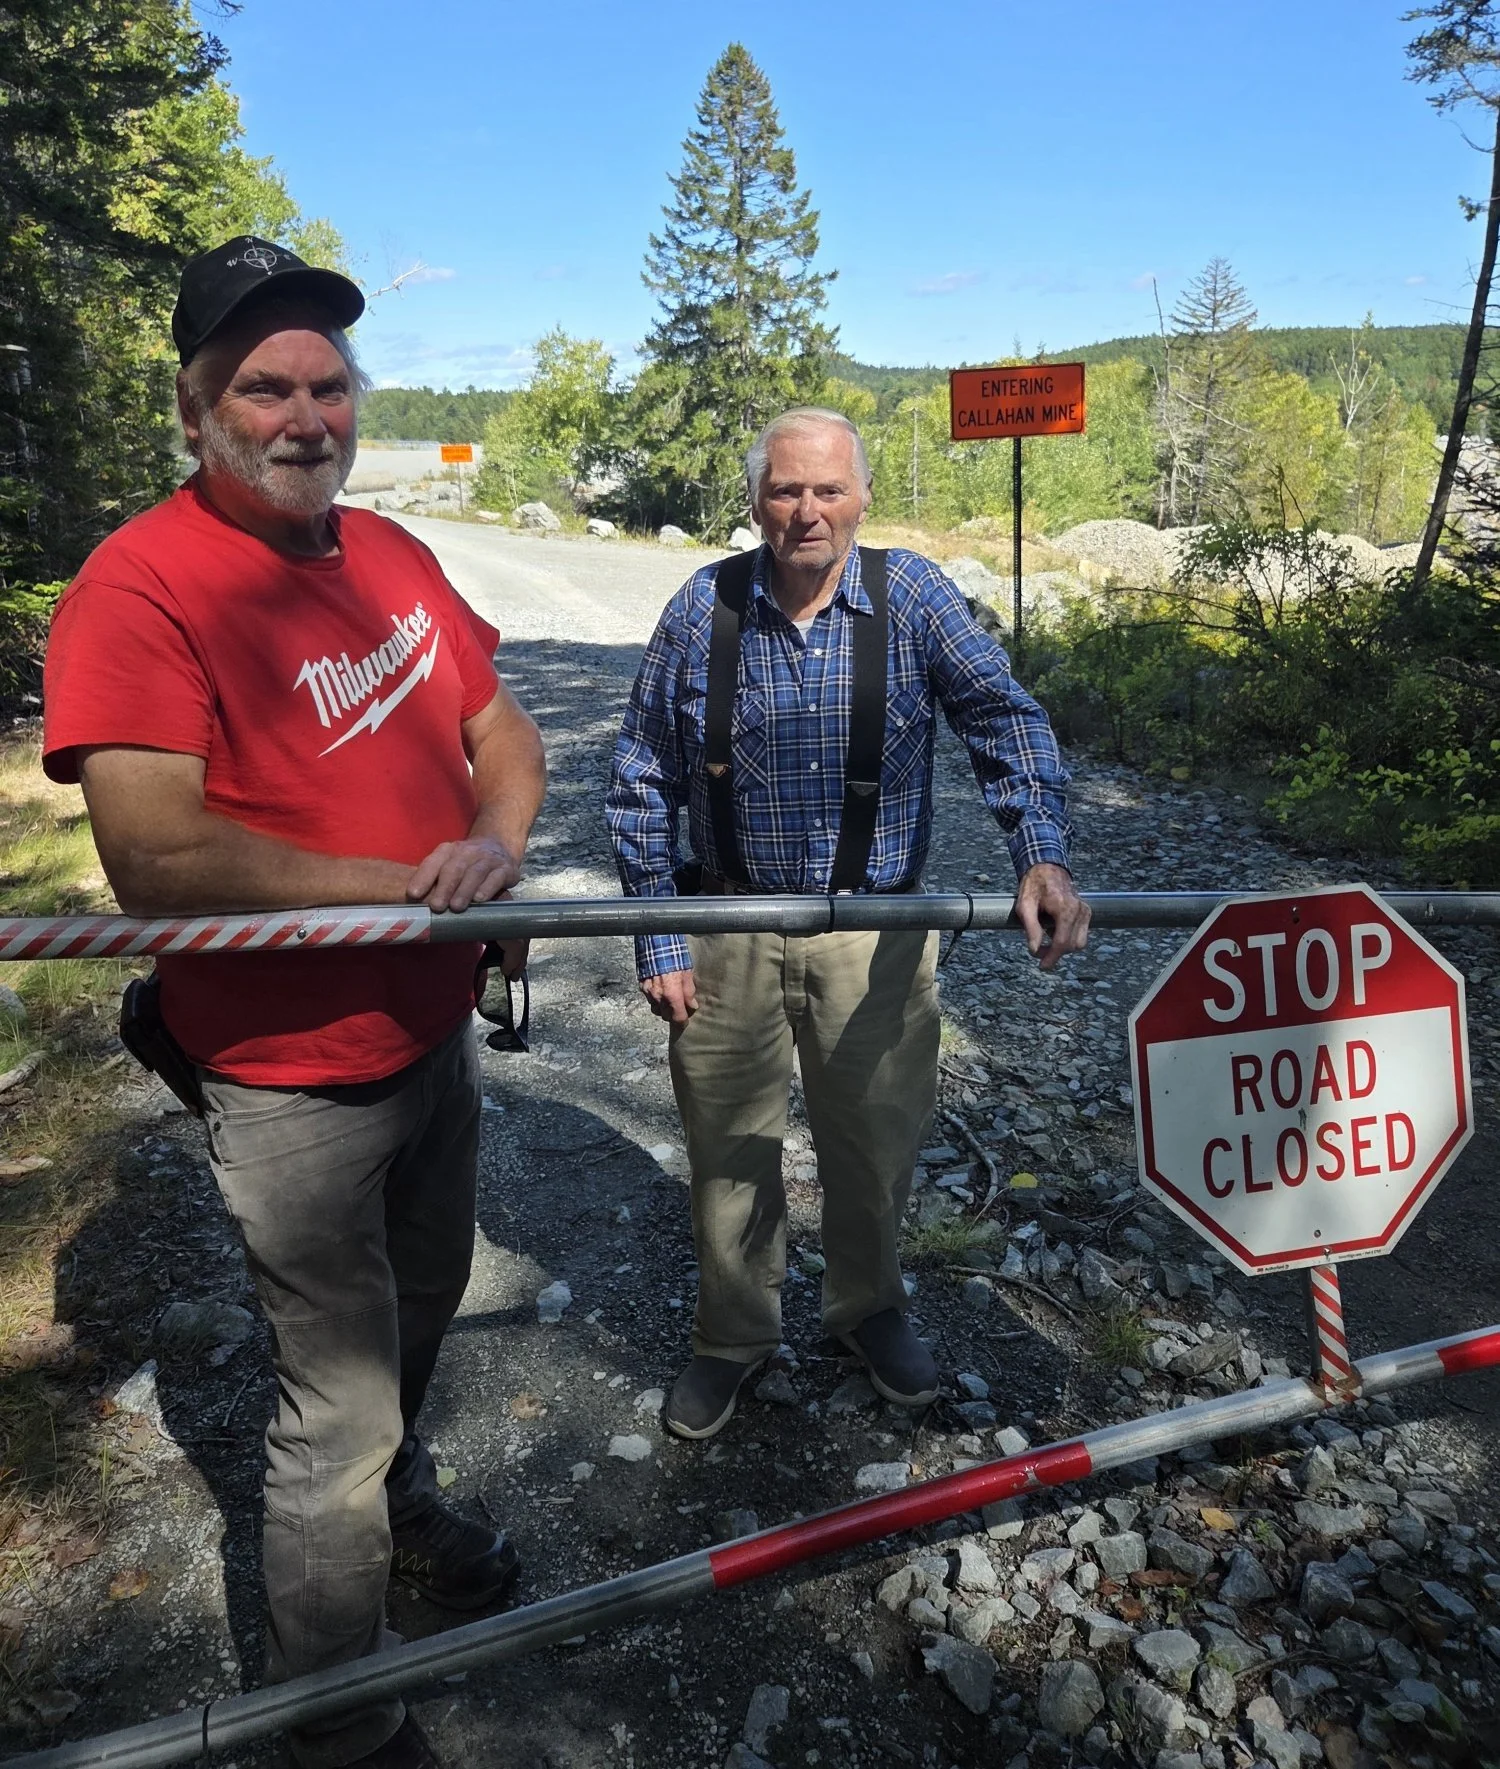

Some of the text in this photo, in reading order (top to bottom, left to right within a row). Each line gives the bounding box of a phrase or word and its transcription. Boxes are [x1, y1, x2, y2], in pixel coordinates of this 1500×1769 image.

[958, 403, 1077, 428] CALLAHAN MINE
[981, 376, 1054, 398] ENTERING
[293, 604, 432, 729] Milwaukee
[1202, 922, 1392, 1023] STOP
[1231, 1040, 1376, 1116] ROAD
[1203, 1112, 1416, 1199] CLOSED
